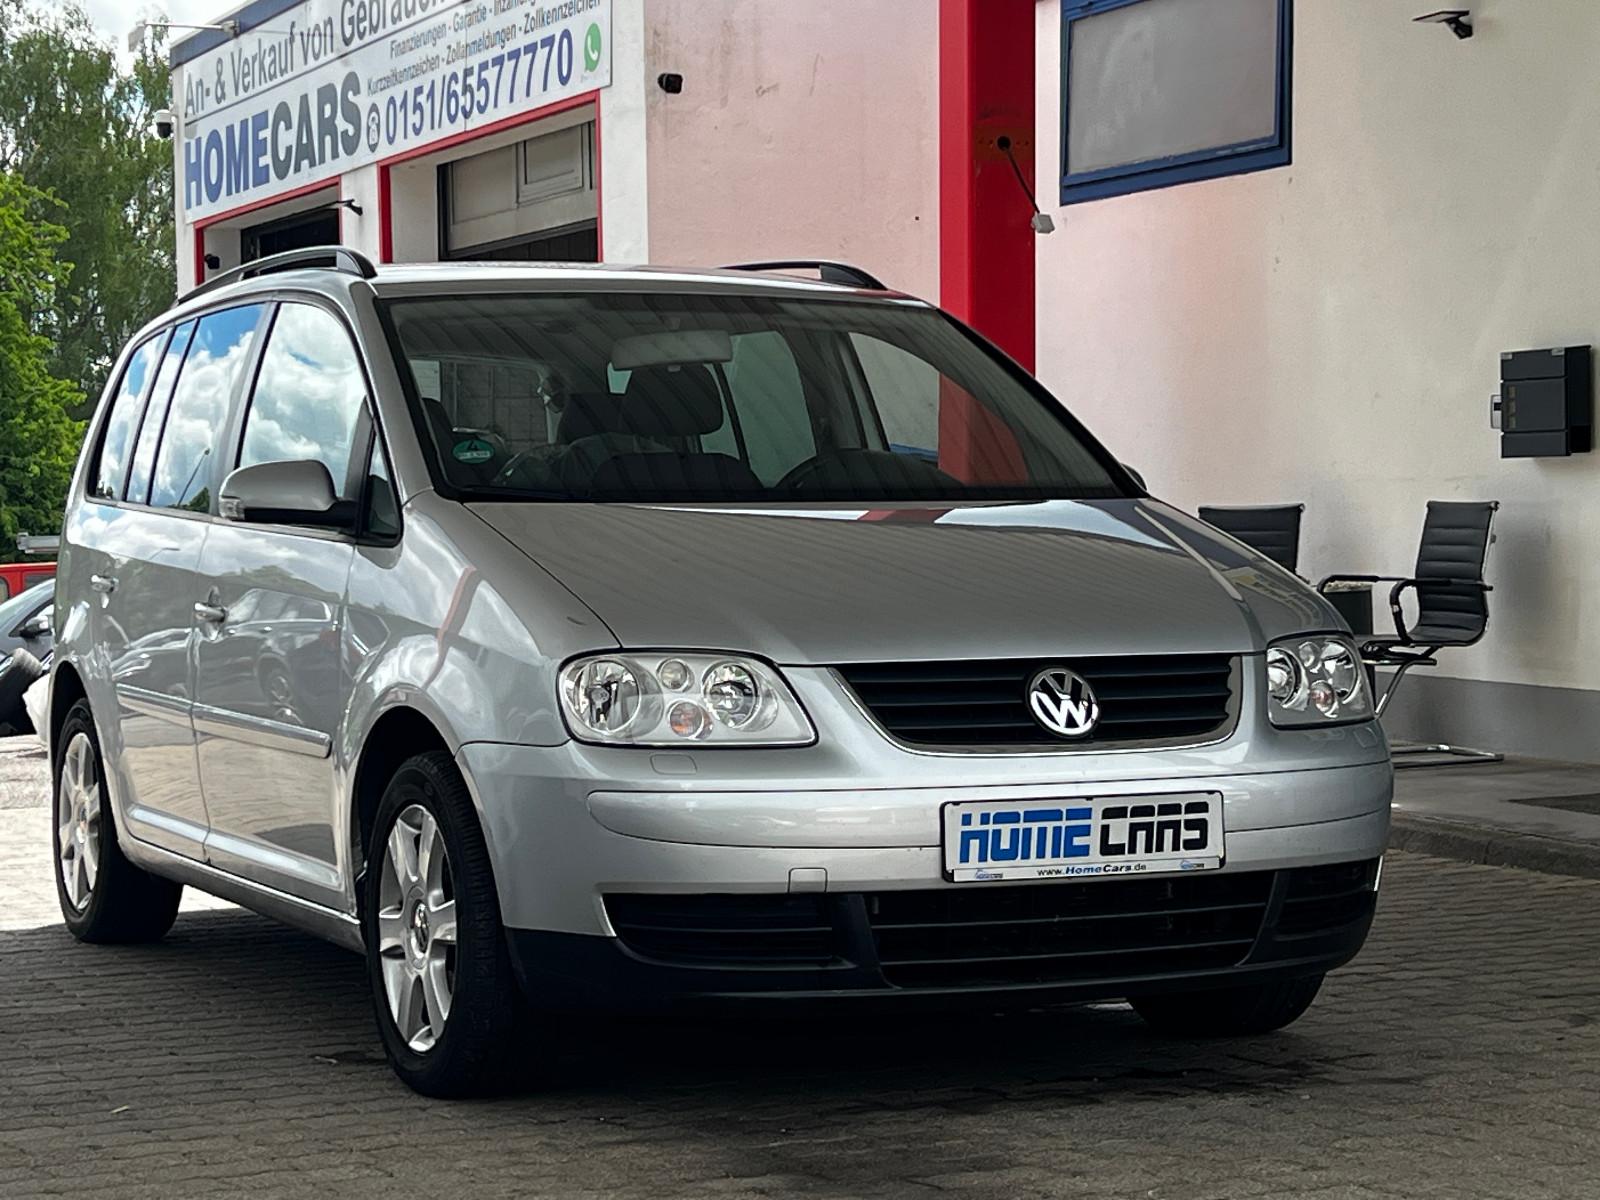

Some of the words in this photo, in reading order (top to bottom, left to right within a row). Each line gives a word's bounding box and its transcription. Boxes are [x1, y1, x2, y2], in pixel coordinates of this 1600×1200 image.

[389, 23, 446, 59] Finanzierungen
[453, 5, 487, 32] Garantie
[446, 22, 517, 65] Zollanmeldungen
[185, 72, 211, 118] An-
[215, 57, 226, 105] &
[230, 21, 296, 97] Verkauf
[300, 16, 334, 66] von
[184, 71, 362, 210] HOMECARS
[386, 28, 573, 146] 0151/65577770
[1036, 862, 1147, 877] www.HomeCars.de
